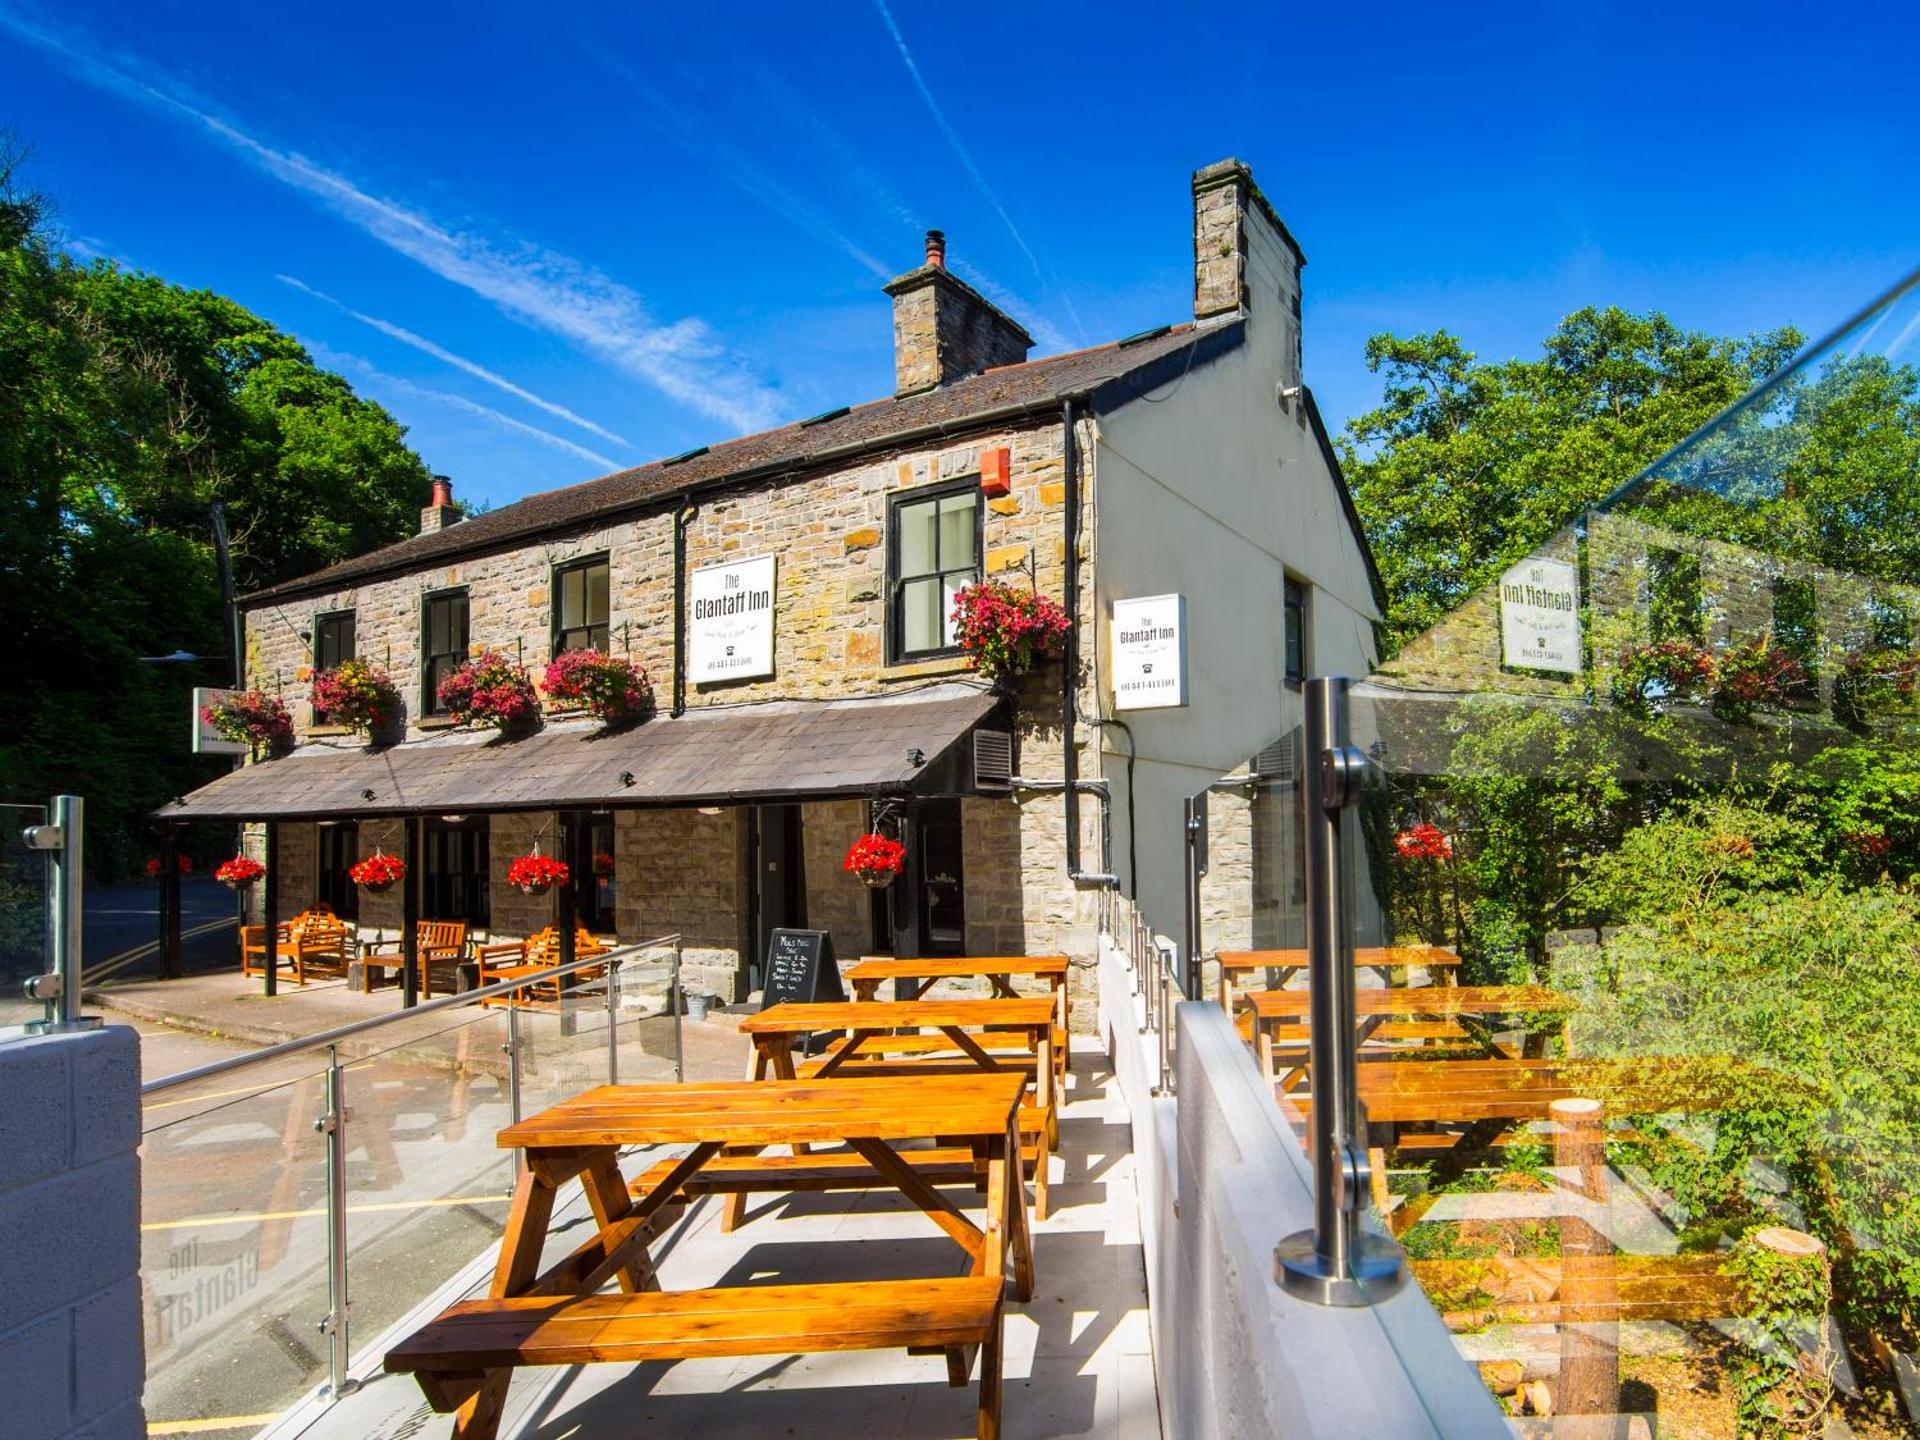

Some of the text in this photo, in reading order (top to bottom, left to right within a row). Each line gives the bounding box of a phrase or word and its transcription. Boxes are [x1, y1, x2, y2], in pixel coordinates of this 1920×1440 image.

[725, 574, 740, 589] The
[696, 590, 769, 620] Glantaff Inn
[1141, 617, 1152, 627] The
[1120, 627, 1175, 644] Glantaff Inn
